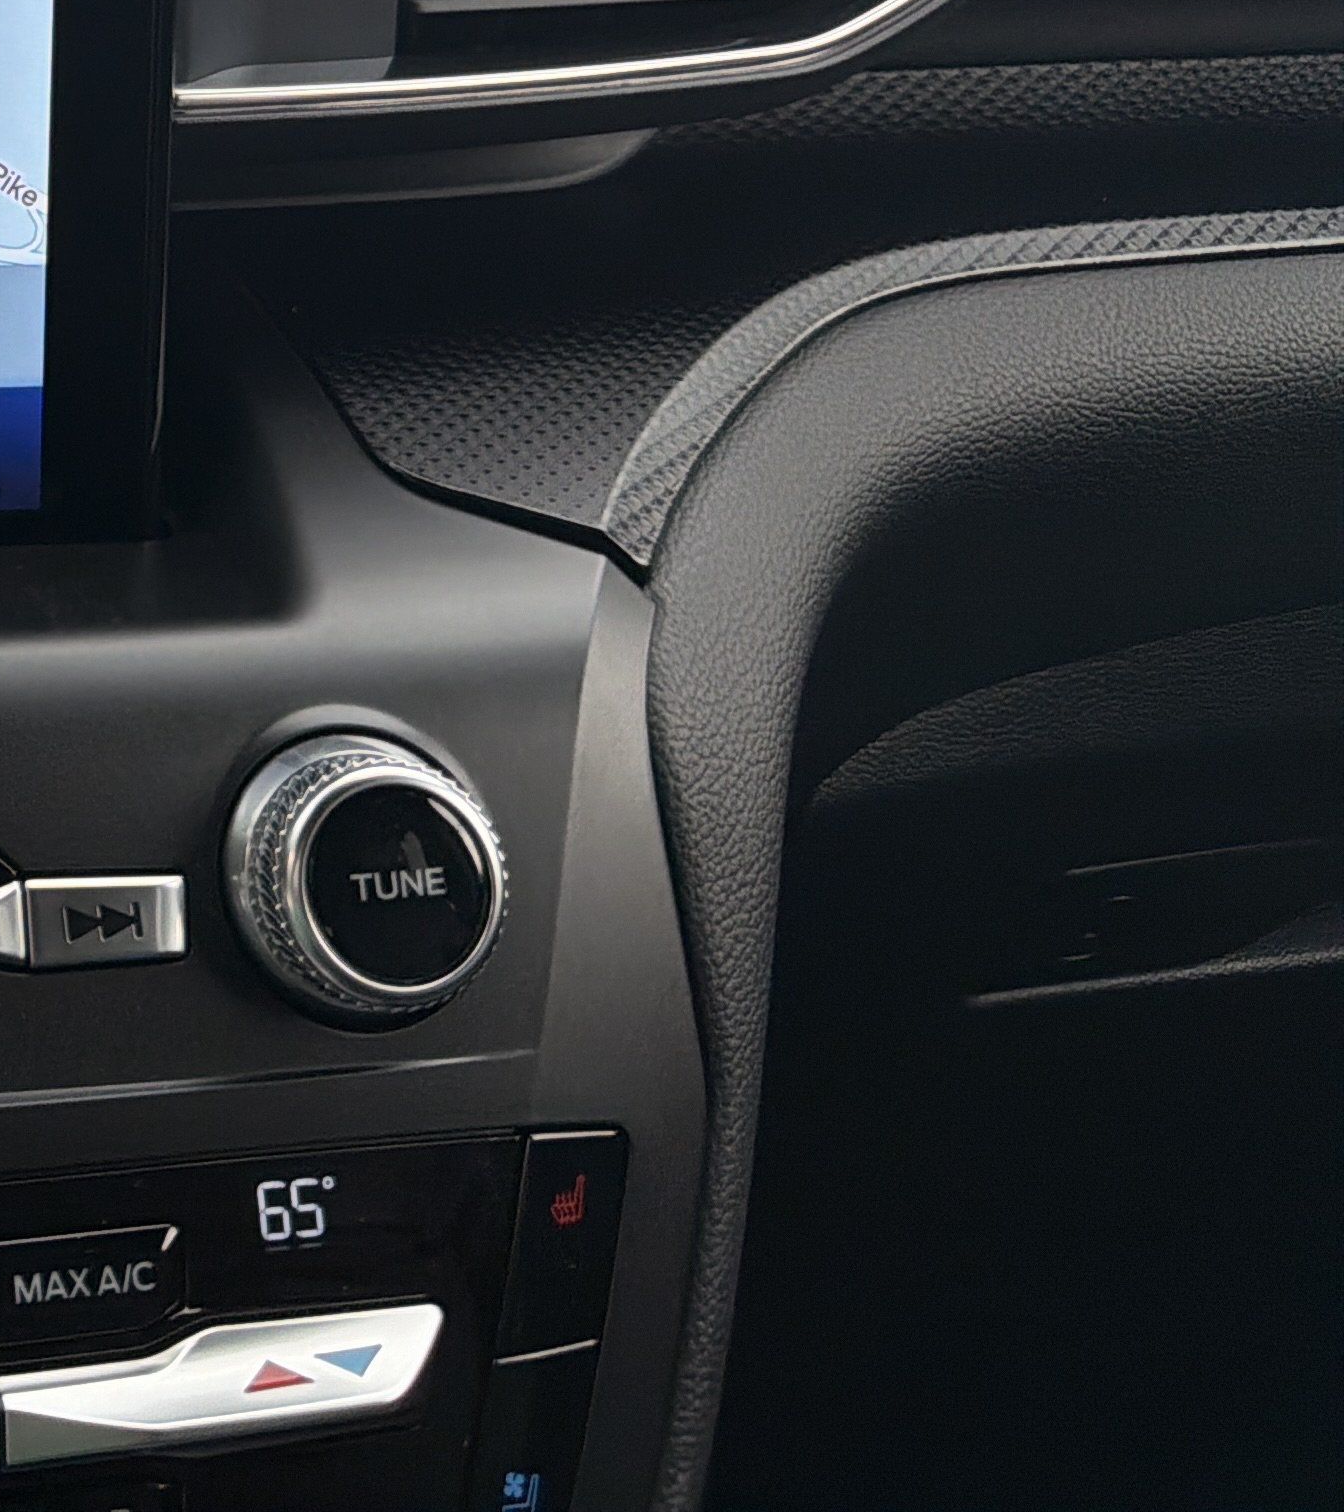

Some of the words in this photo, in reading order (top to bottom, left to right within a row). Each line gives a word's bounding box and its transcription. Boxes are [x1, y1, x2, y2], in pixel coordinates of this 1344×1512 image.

[348, 865, 447, 903] TUNE
[256, 1174, 337, 1241] 65°
[12, 1265, 90, 1305] MAX
[96, 1260, 157, 1292] A/C
